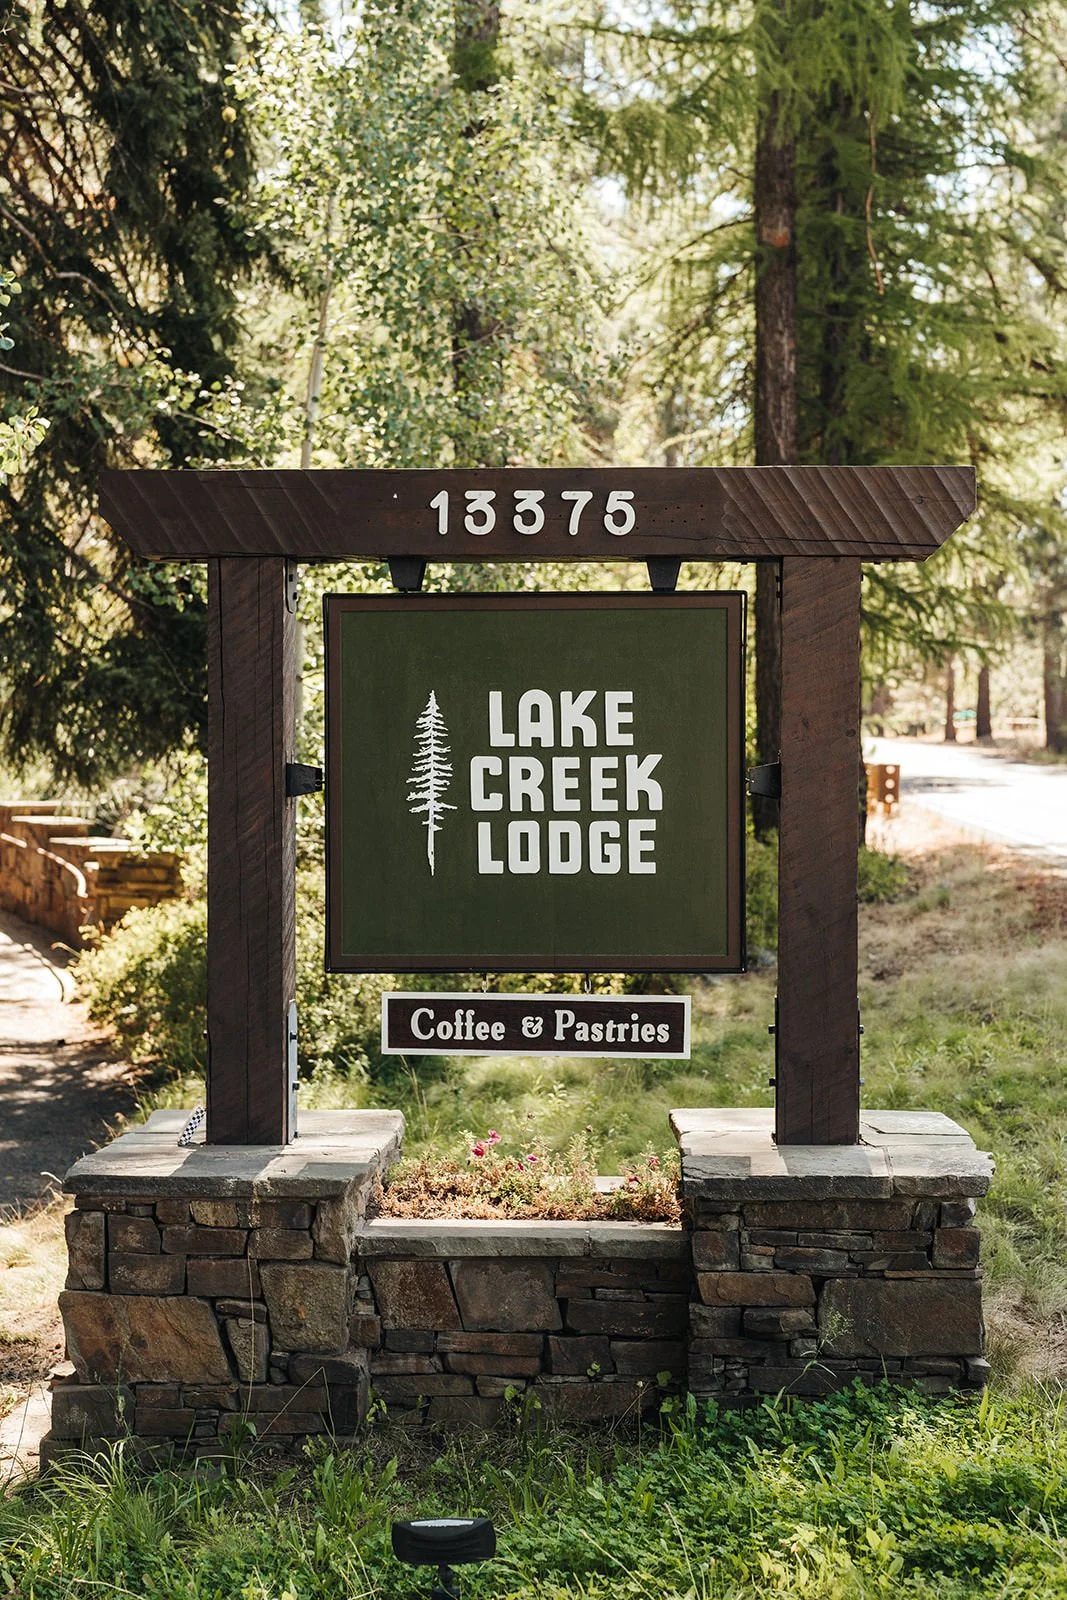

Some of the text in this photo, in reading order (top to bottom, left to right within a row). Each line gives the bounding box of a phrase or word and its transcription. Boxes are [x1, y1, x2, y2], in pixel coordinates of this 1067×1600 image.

[429, 489, 637, 536] 13375
[489, 688, 635, 748] LAKE
[470, 753, 663, 812] CREEK
[477, 818, 657, 875] LODGE
[410, 1007, 670, 1043] Coffee & Pastries
